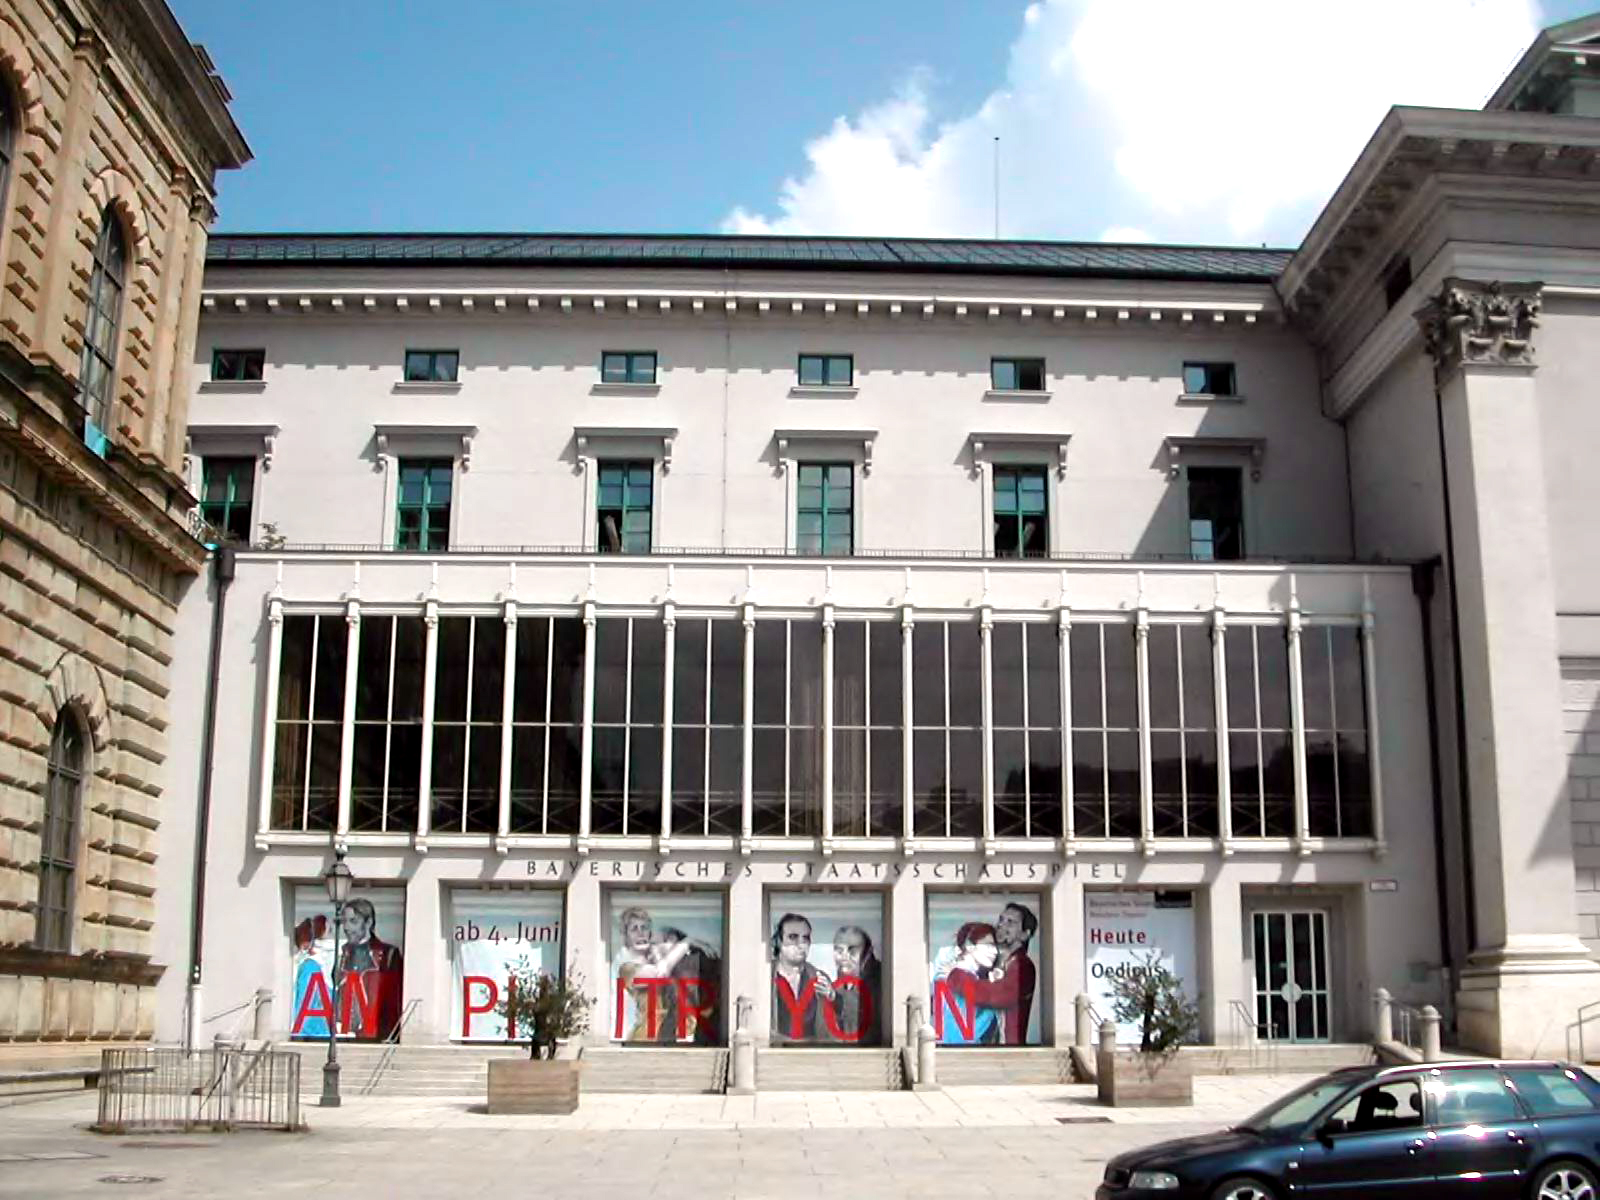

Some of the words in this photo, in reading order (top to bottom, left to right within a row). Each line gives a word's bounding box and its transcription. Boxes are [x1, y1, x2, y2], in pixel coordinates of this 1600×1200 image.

[526, 861, 753, 878] BAYERISCHES
[785, 862, 1124, 878] STAATSSCHAUSPIEL
[454, 920, 480, 941] ab
[487, 925, 508, 946] 4.
[514, 921, 559, 944] Juni
[1090, 928, 1147, 944] Heute
[933, 979, 976, 1041] N
